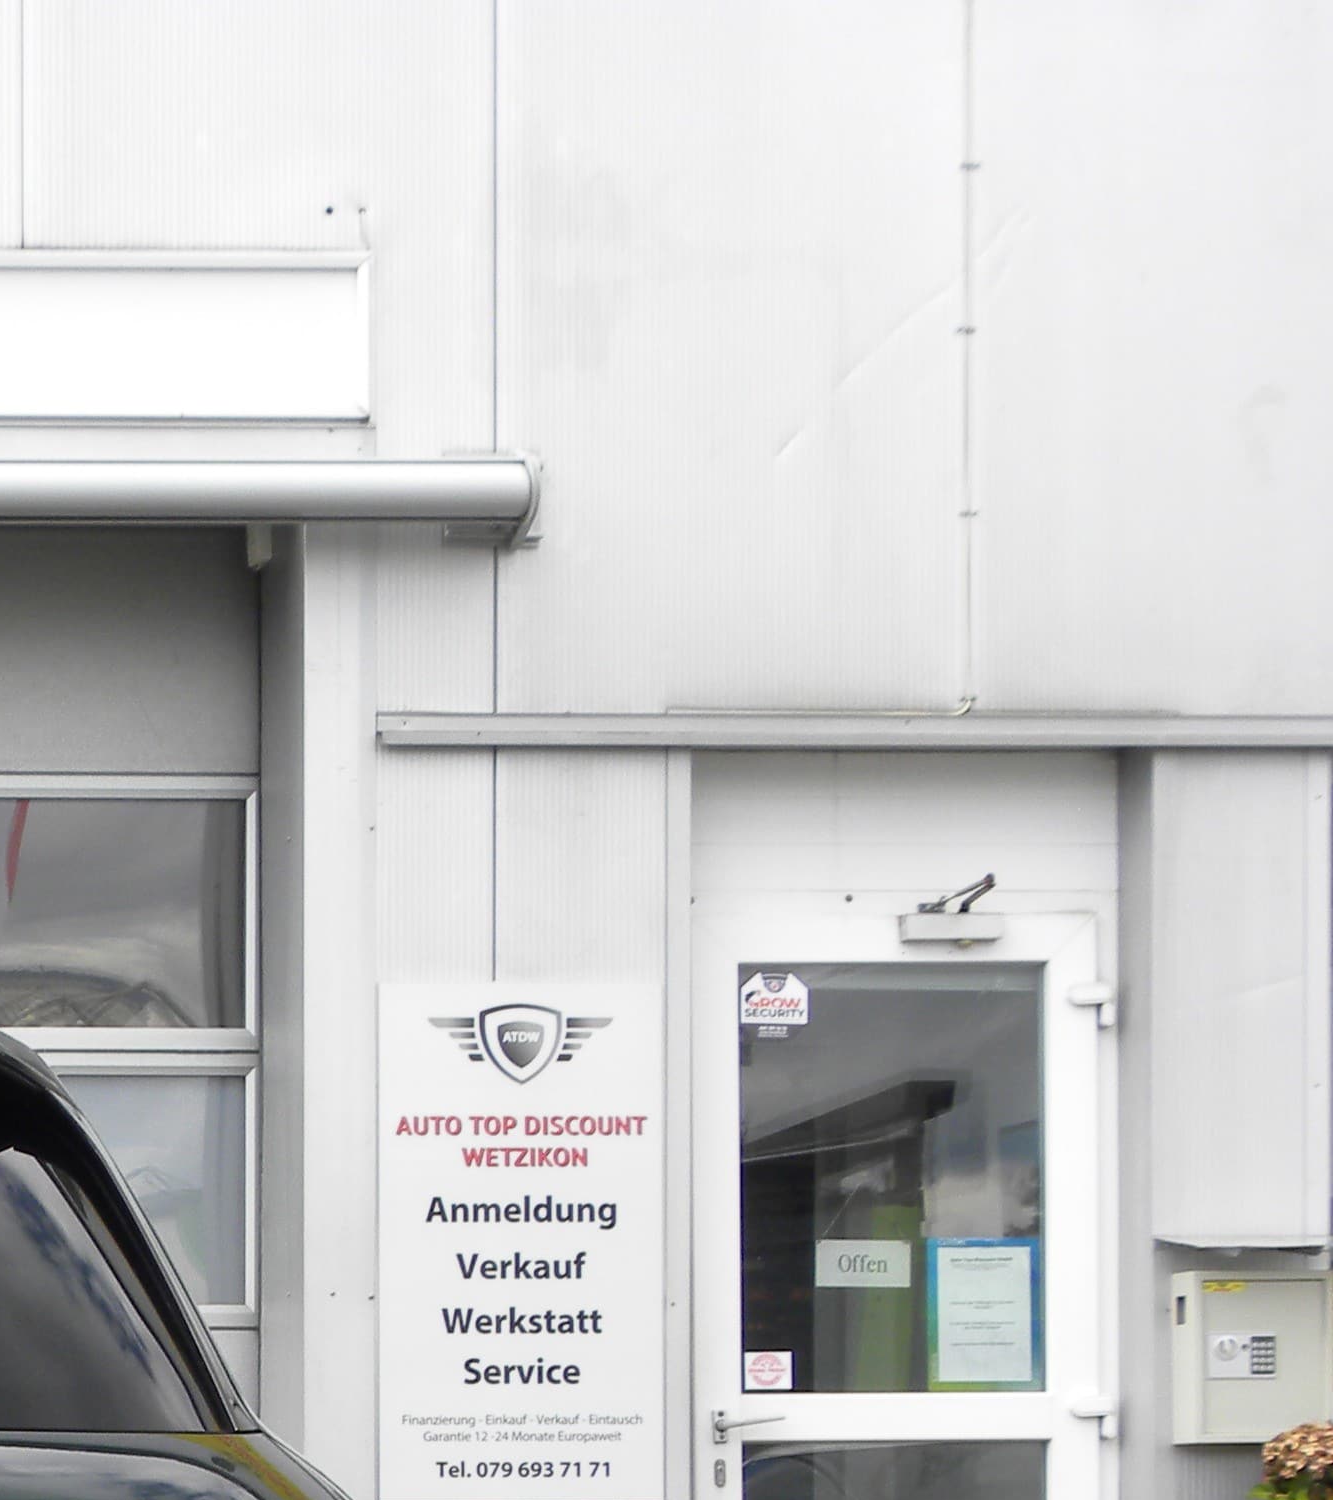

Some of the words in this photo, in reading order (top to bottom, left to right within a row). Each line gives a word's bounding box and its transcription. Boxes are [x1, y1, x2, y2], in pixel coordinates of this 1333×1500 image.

[744, 1008, 805, 1018] SECURITY
[502, 1031, 541, 1043] ATDW
[396, 1116, 462, 1136] AUTO
[468, 1116, 518, 1136] TOP
[524, 1116, 648, 1136] DISCOUNT
[461, 1147, 588, 1167] WETZIKON
[425, 1195, 618, 1230] Anmeldung
[455, 1251, 588, 1280] Verkauf
[838, 1253, 887, 1273] Offen
[441, 1306, 603, 1334] Werkstatt
[463, 1357, 581, 1385] Service
[401, 1414, 476, 1427] Finanzierung
[485, 1414, 528, 1425] Einkauf
[536, 1414, 580, 1425] Verkauf
[588, 1414, 643, 1425] Eintausch
[422, 1430, 472, 1442] Garantie
[475, 1431, 489, 1442] 12
[511, 1430, 555, 1442] Monate
[557, 1430, 622, 1444] Europaweit
[435, 1460, 472, 1478] Tel.
[476, 1461, 513, 1478] 079
[517, 1461, 554, 1478] 693
[560, 1461, 582, 1478] 71
[588, 1461, 612, 1478] 71
